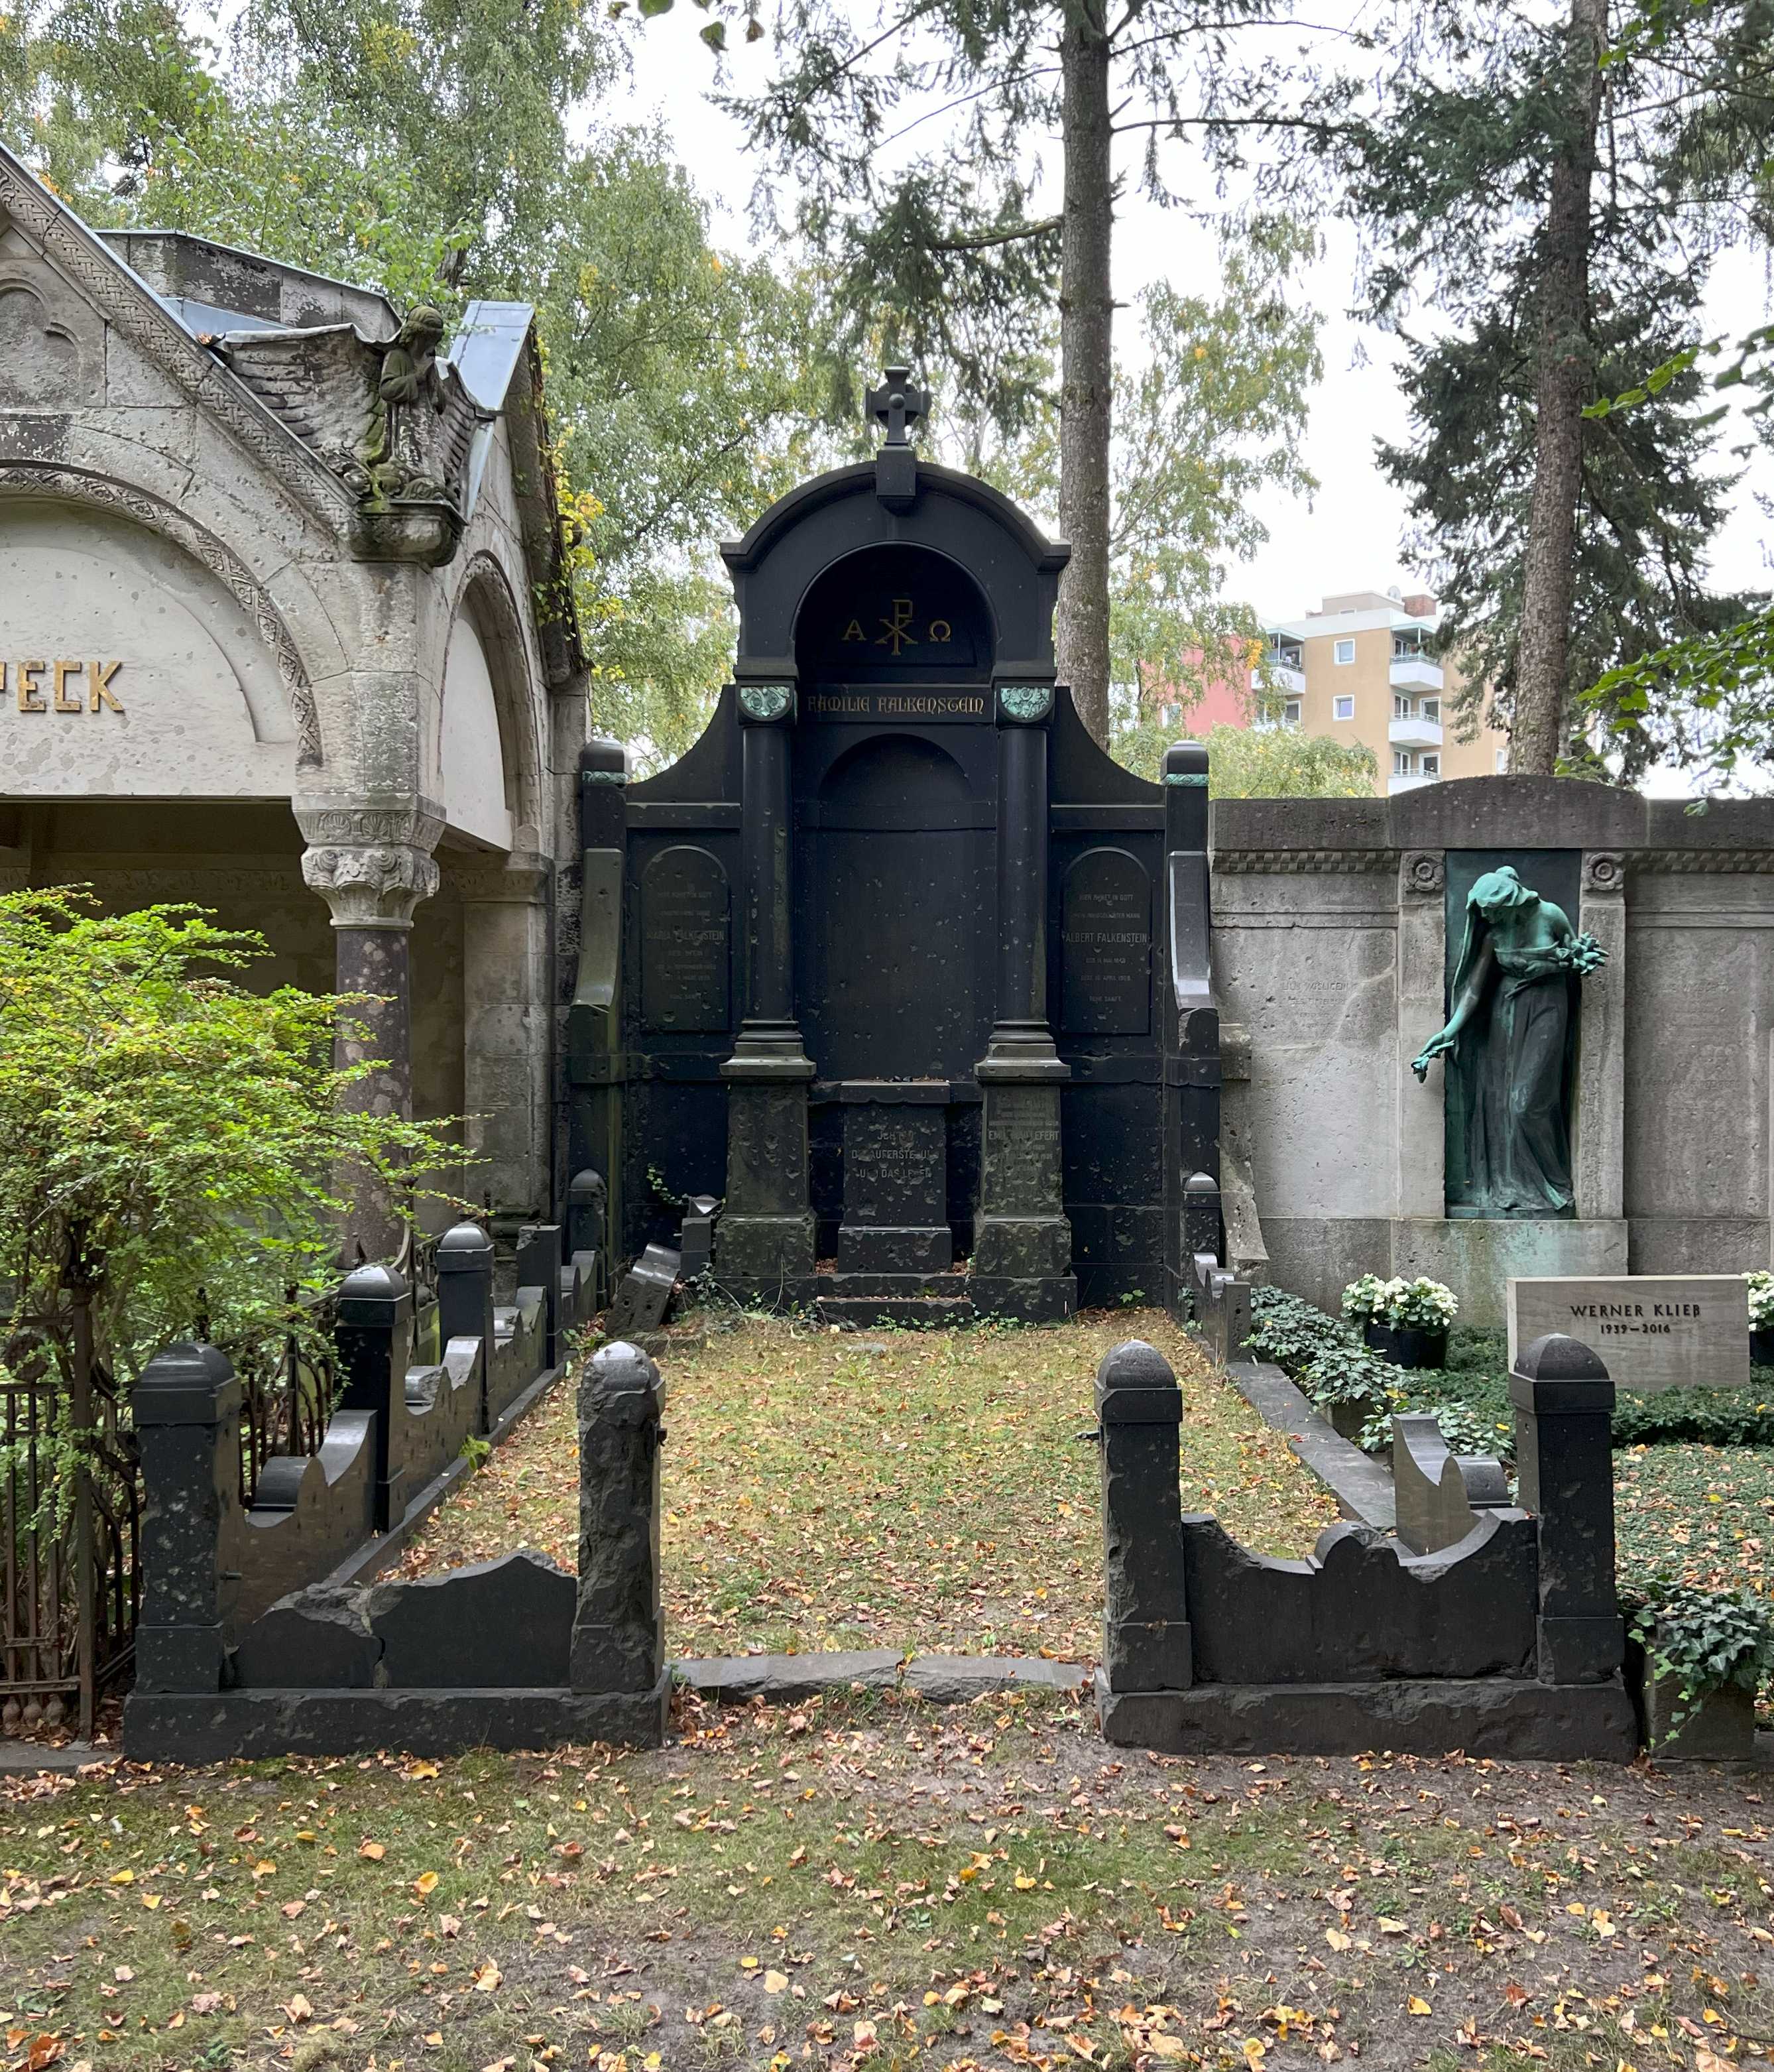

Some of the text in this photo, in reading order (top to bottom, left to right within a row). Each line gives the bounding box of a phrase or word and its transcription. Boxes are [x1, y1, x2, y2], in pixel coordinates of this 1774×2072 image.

[0, 660, 124, 712] ECK
[807, 696, 984, 715] FAMILIE FALKENSTEIN
[1065, 932, 1147, 943] ALBERT FALKENSTEIN
[1569, 1304, 1644, 1317] WERNER
